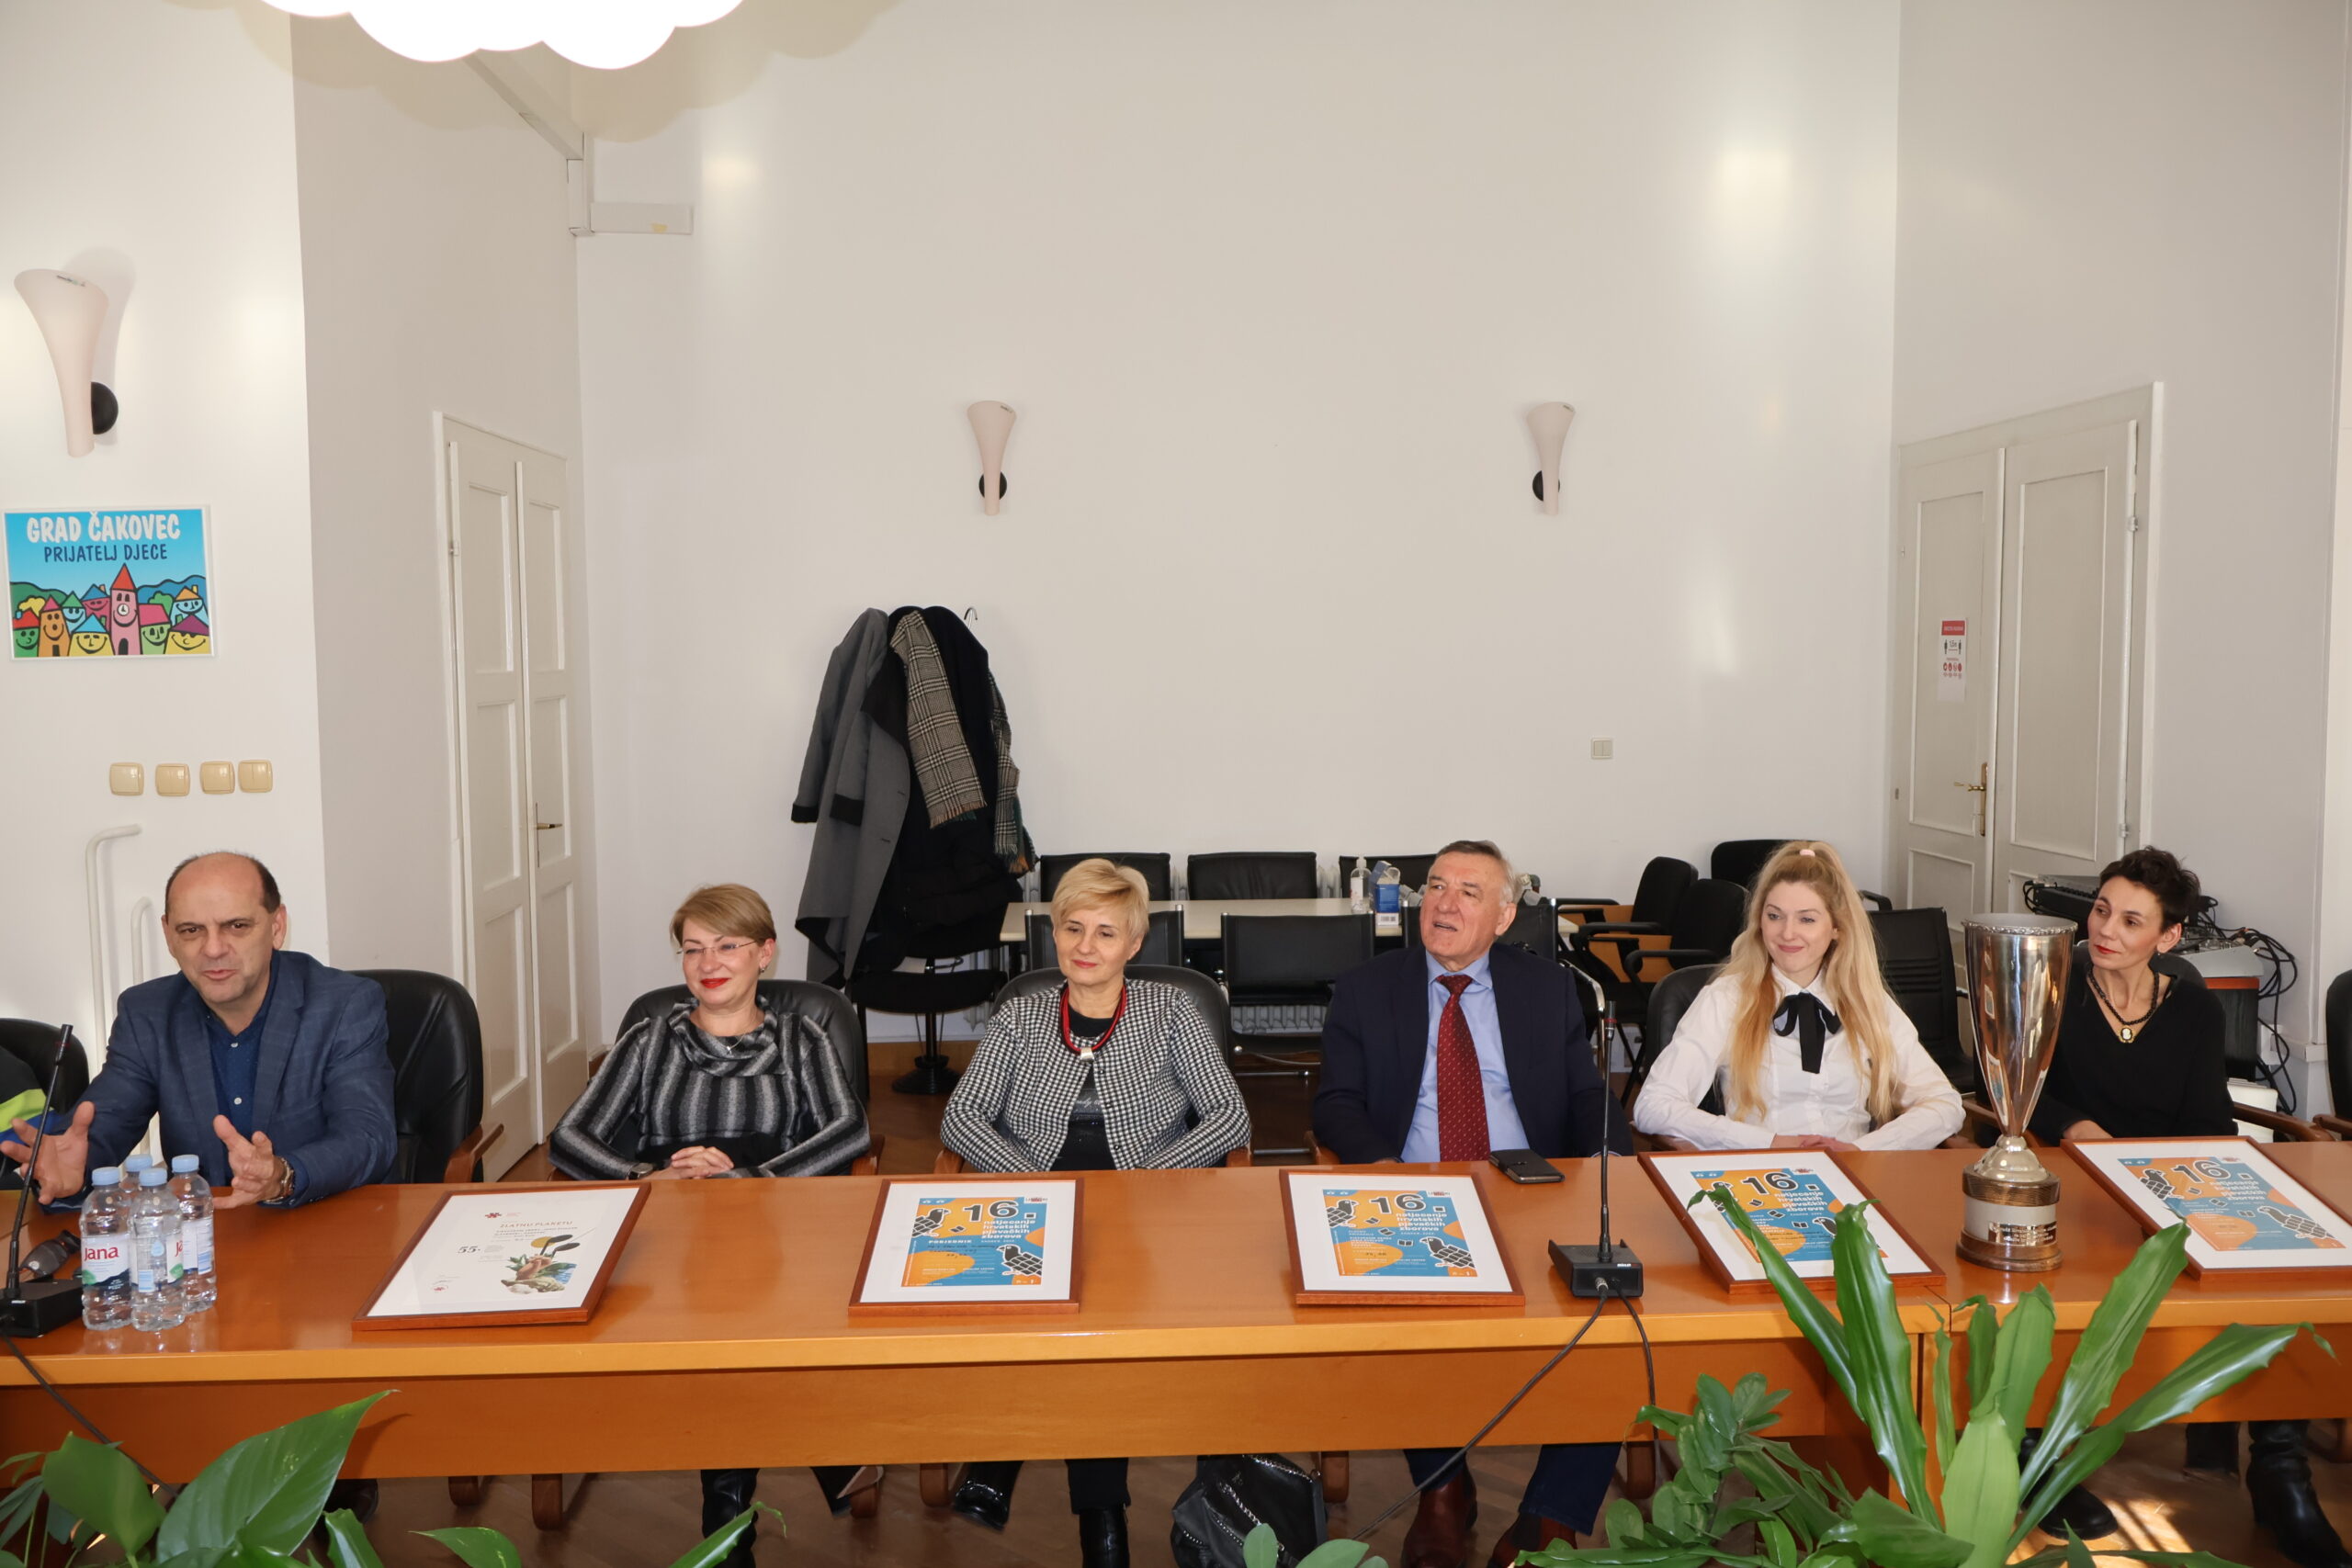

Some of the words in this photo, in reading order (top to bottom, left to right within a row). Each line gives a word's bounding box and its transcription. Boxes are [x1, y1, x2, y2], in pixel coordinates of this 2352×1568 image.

[27, 516, 82, 543] GRAD
[88, 511, 181, 542] ČAKOVEC
[44, 545, 117, 562] PRIJATELJ
[124, 544, 167, 560] DJECE
[2172, 1160, 2254, 1183] 16.
[1741, 1172, 1820, 1195] 16.
[963, 1200, 1036, 1222] 16.
[1369, 1193, 1445, 1213] 16.
[85, 1247, 119, 1261] Jana
